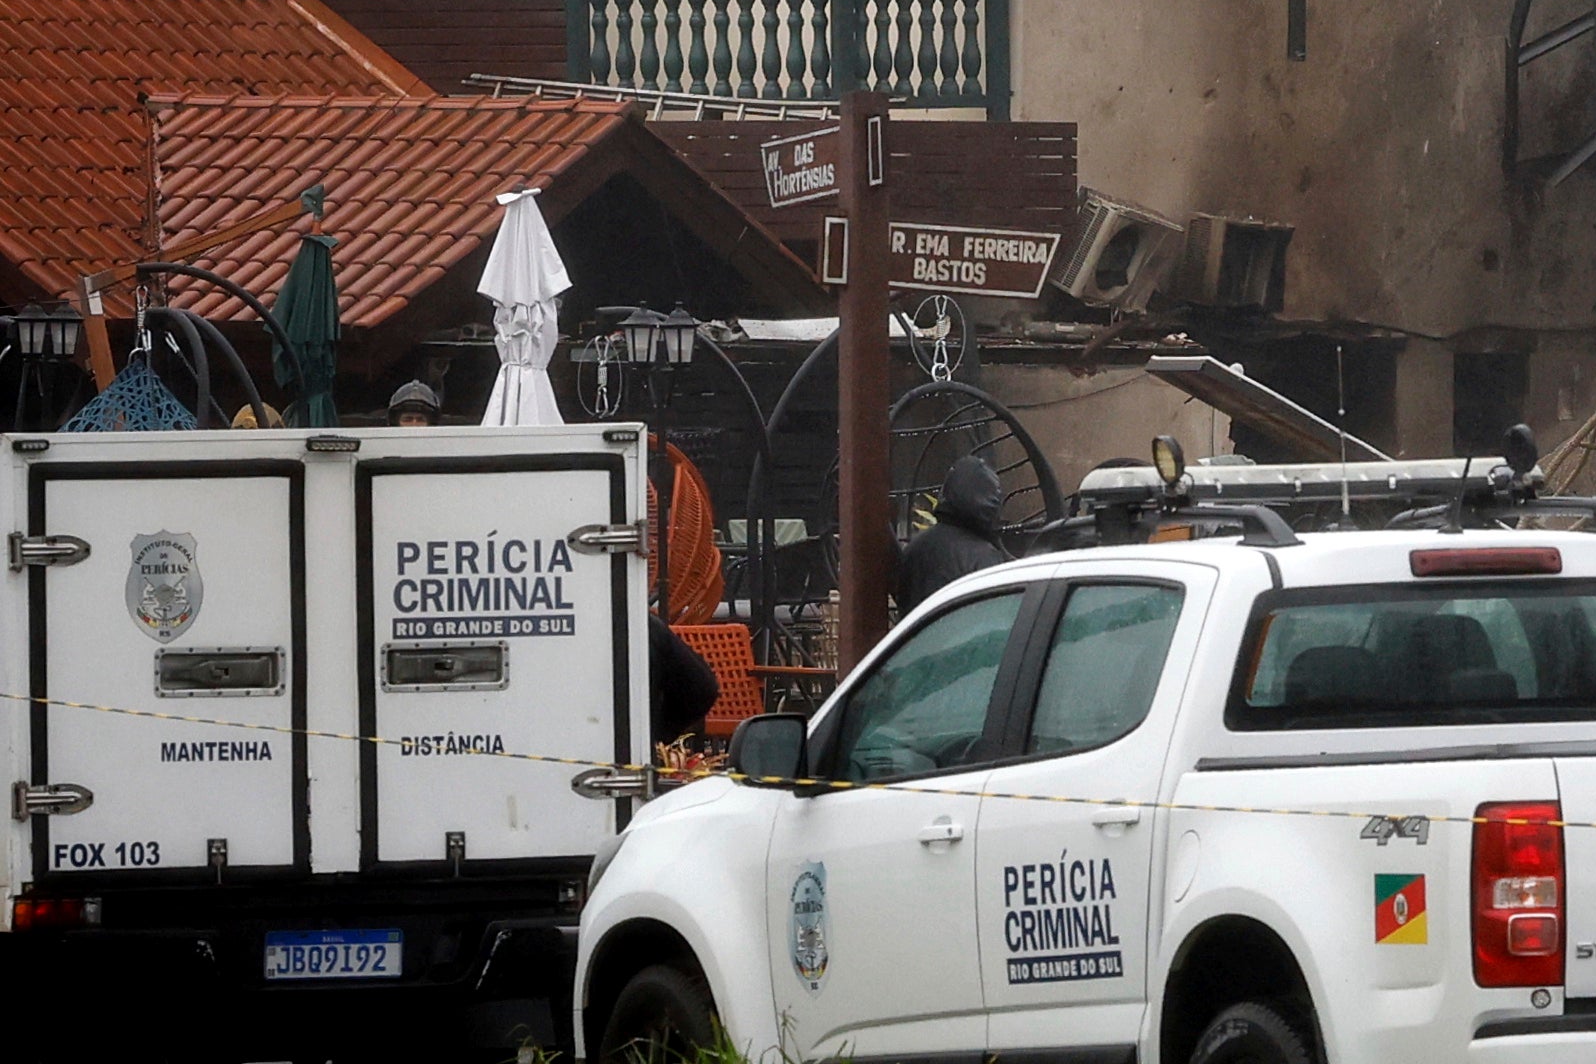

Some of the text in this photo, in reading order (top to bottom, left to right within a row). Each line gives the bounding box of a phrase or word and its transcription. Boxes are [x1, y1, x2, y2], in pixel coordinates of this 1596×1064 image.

[793, 141, 815, 167] DAS
[915, 233, 949, 256] EMA
[963, 236, 1048, 264] FERREIRA
[913, 257, 987, 285] BASTOS
[397, 529, 573, 575] PERÍCIA
[141, 561, 189, 575] PERÍCIAS
[393, 576, 574, 613] CRIMINAL
[396, 619, 572, 636] RIO GRANDE DO SUL
[161, 740, 272, 762] MANTENHA
[401, 731, 505, 756] DISTÂNCIA
[54, 841, 160, 868] FOX 103
[1004, 848, 1116, 907] PERÍCIA
[1004, 904, 1120, 952] CRIMINAL
[277, 945, 387, 974] JBQ9I92
[1009, 956, 1121, 981] RIO GRANDE DO SUL
